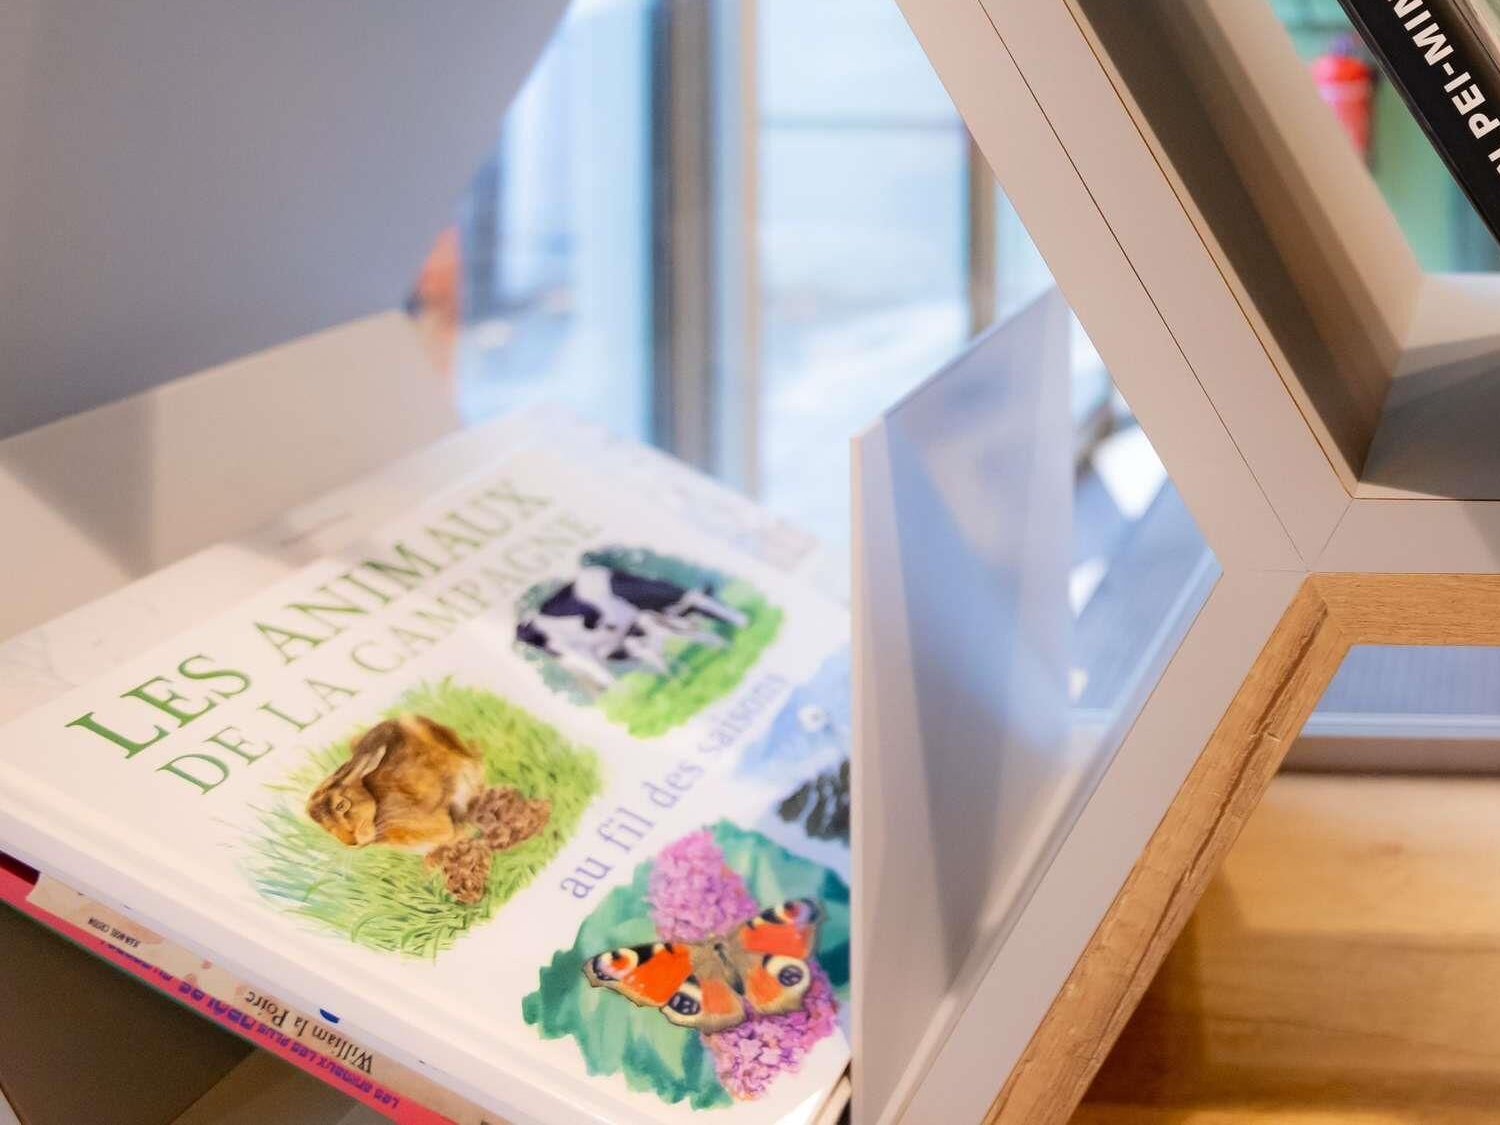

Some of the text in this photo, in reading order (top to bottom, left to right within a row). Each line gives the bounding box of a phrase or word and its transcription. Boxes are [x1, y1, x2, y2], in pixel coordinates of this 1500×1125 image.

[65, 480, 553, 759] LES ANIMAUX
[155, 514, 602, 795] DE LA CAMPAGNE
[560, 856, 614, 899] au
[597, 806, 655, 852] fil
[643, 760, 705, 809] des
[244, 990, 373, 1074] William la Poire
